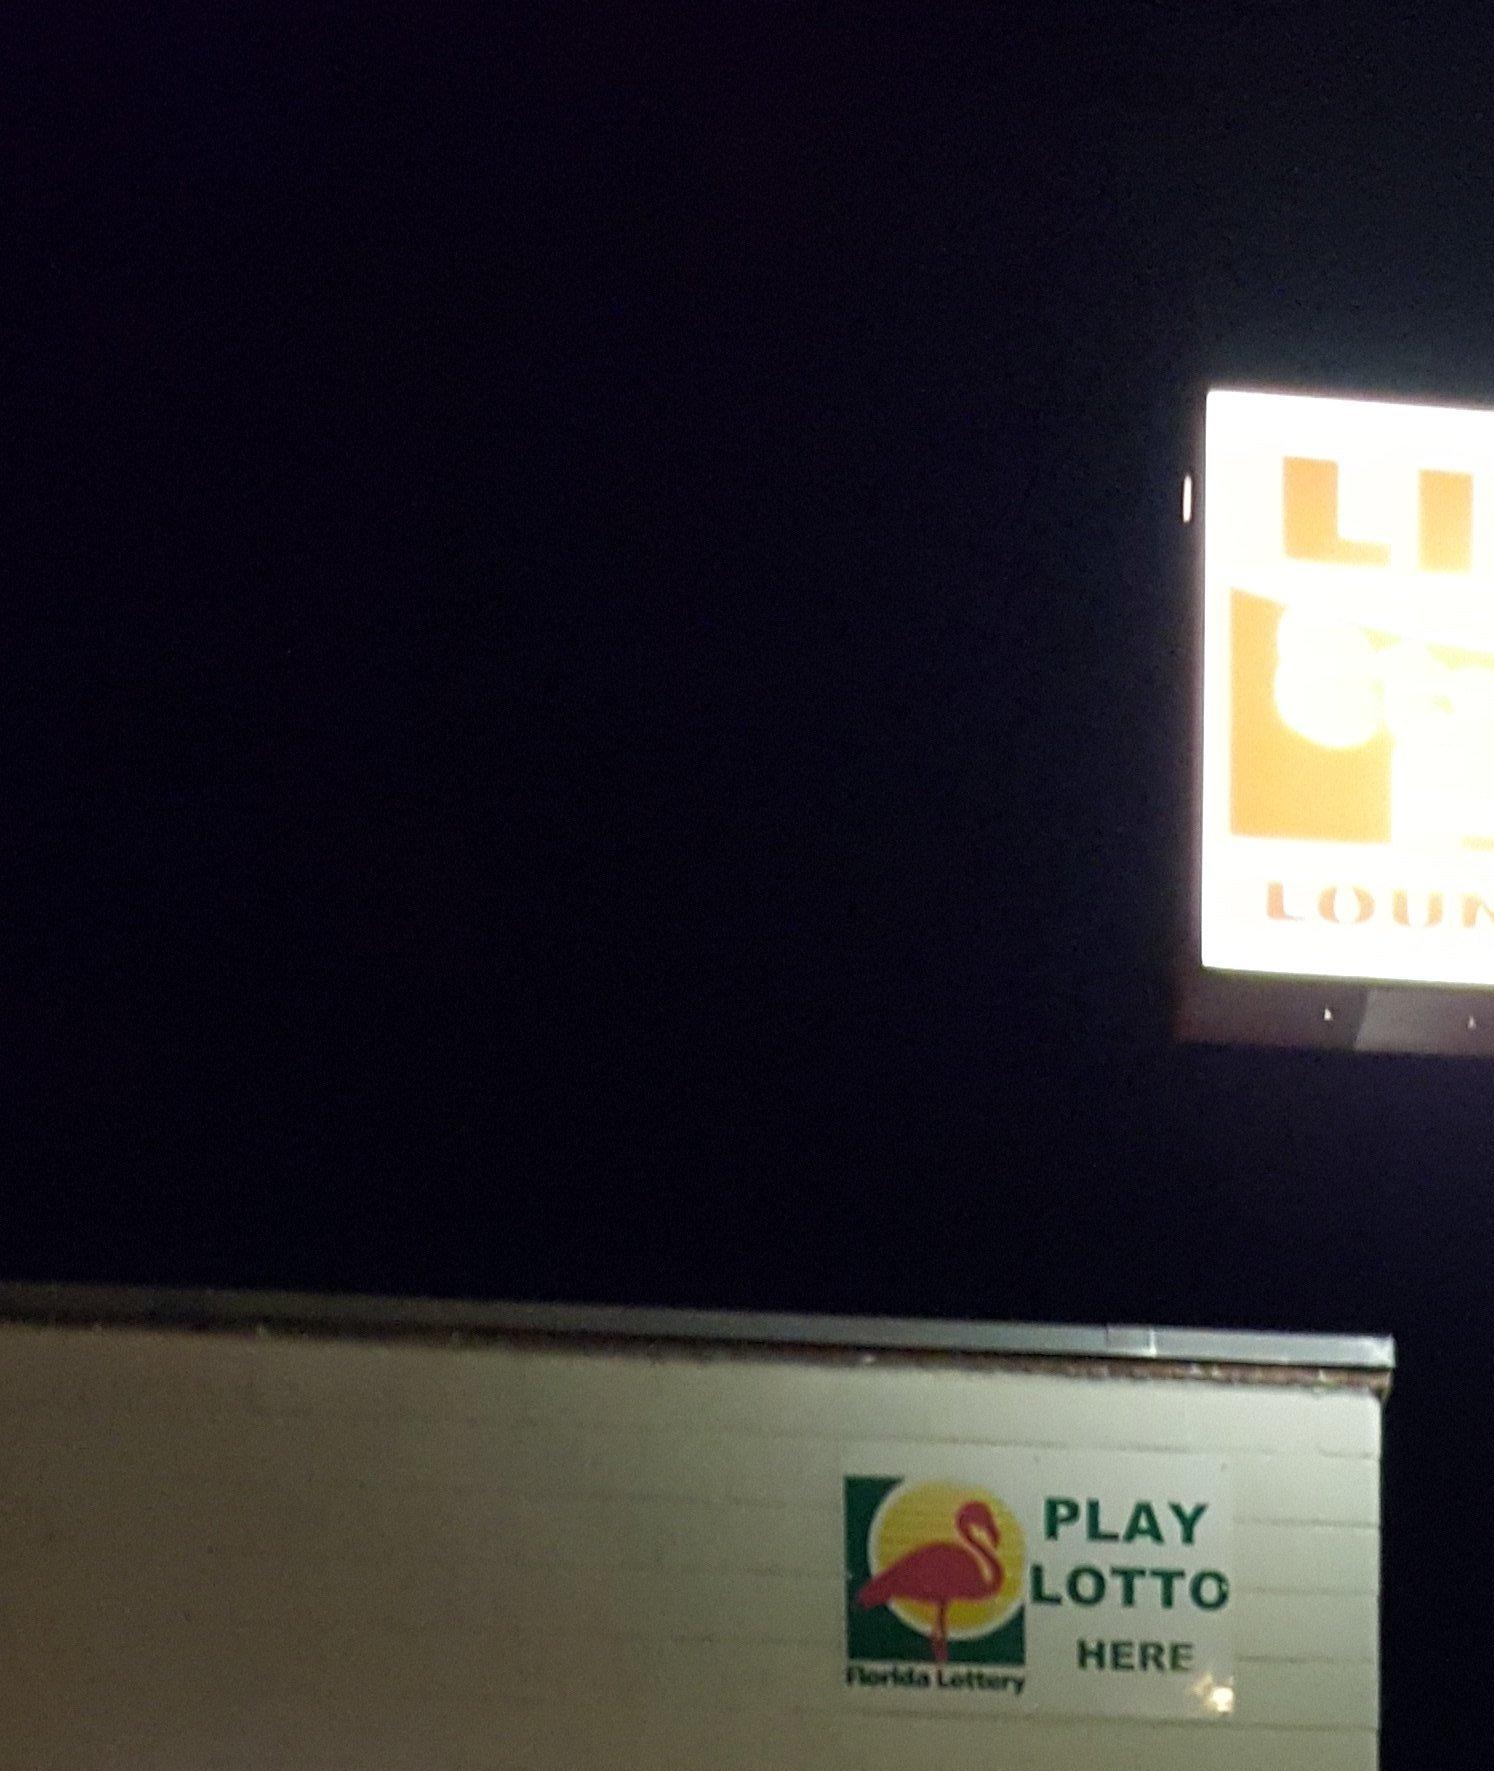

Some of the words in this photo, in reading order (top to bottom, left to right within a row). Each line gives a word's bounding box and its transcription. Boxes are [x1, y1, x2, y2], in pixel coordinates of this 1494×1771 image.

[1044, 1497, 1208, 1545] PLAY
[1029, 1564, 1230, 1610] LOTTO
[1077, 1640, 1193, 1672] HERE
[846, 1664, 931, 1687] Florida
[936, 1668, 1025, 1696] Lottery
